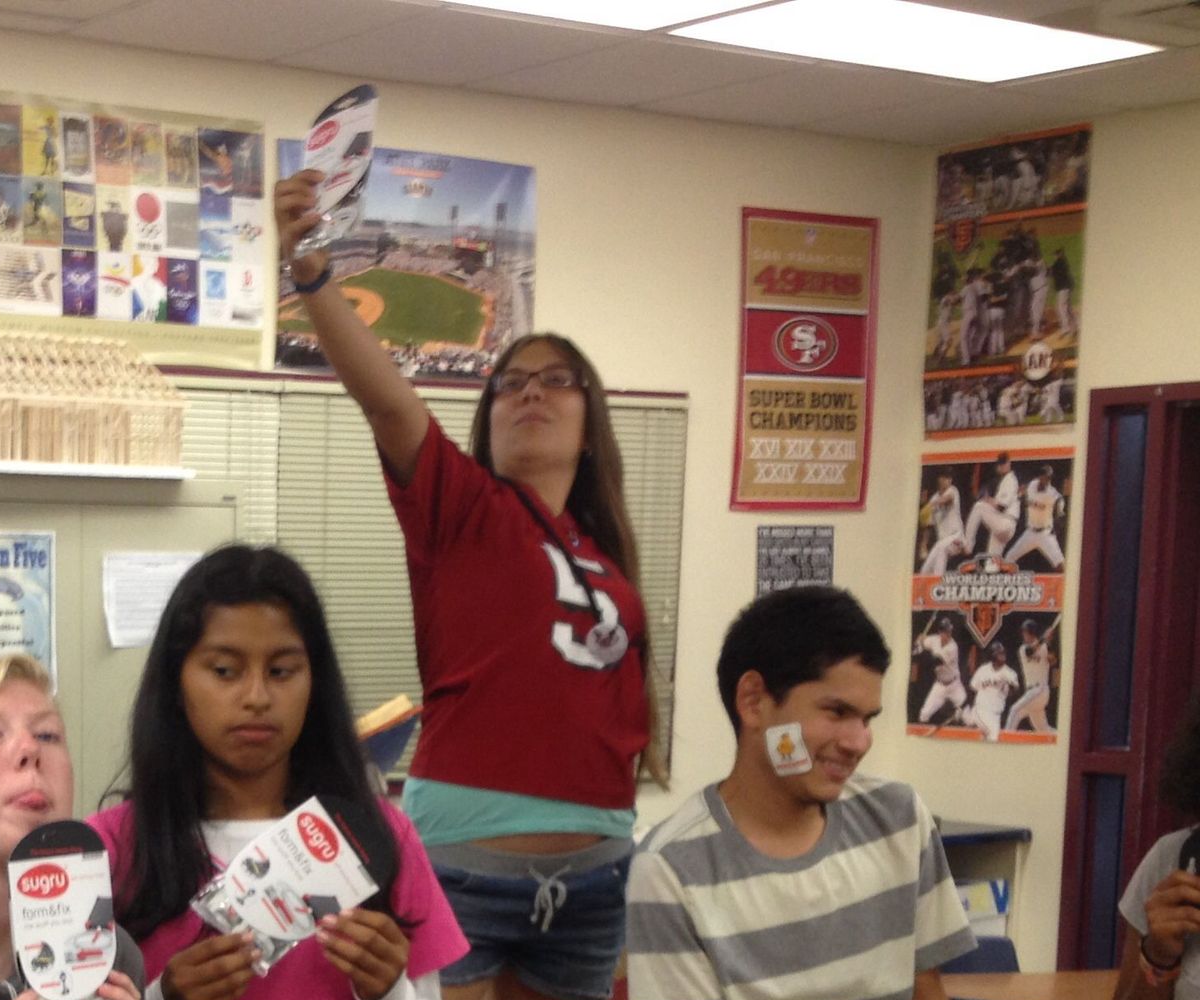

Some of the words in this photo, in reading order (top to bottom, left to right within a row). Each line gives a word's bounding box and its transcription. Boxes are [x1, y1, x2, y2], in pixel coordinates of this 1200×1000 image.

[753, 264, 864, 297] 49ERS
[750, 389, 805, 409] SUPER
[809, 391, 858, 411] BOWL
[749, 411, 858, 432] CHAMPIONS
[750, 438, 781, 460] XVI
[784, 438, 816, 460] XIX
[13, 541, 48, 569] Five
[943, 574, 989, 586] WORLD
[989, 573, 1032, 586] SERIES
[932, 585, 1042, 602] CHAMPIONS
[301, 814, 336, 859] sugru
[20, 871, 66, 895] sugru
[21, 902, 71, 920] form&fix
